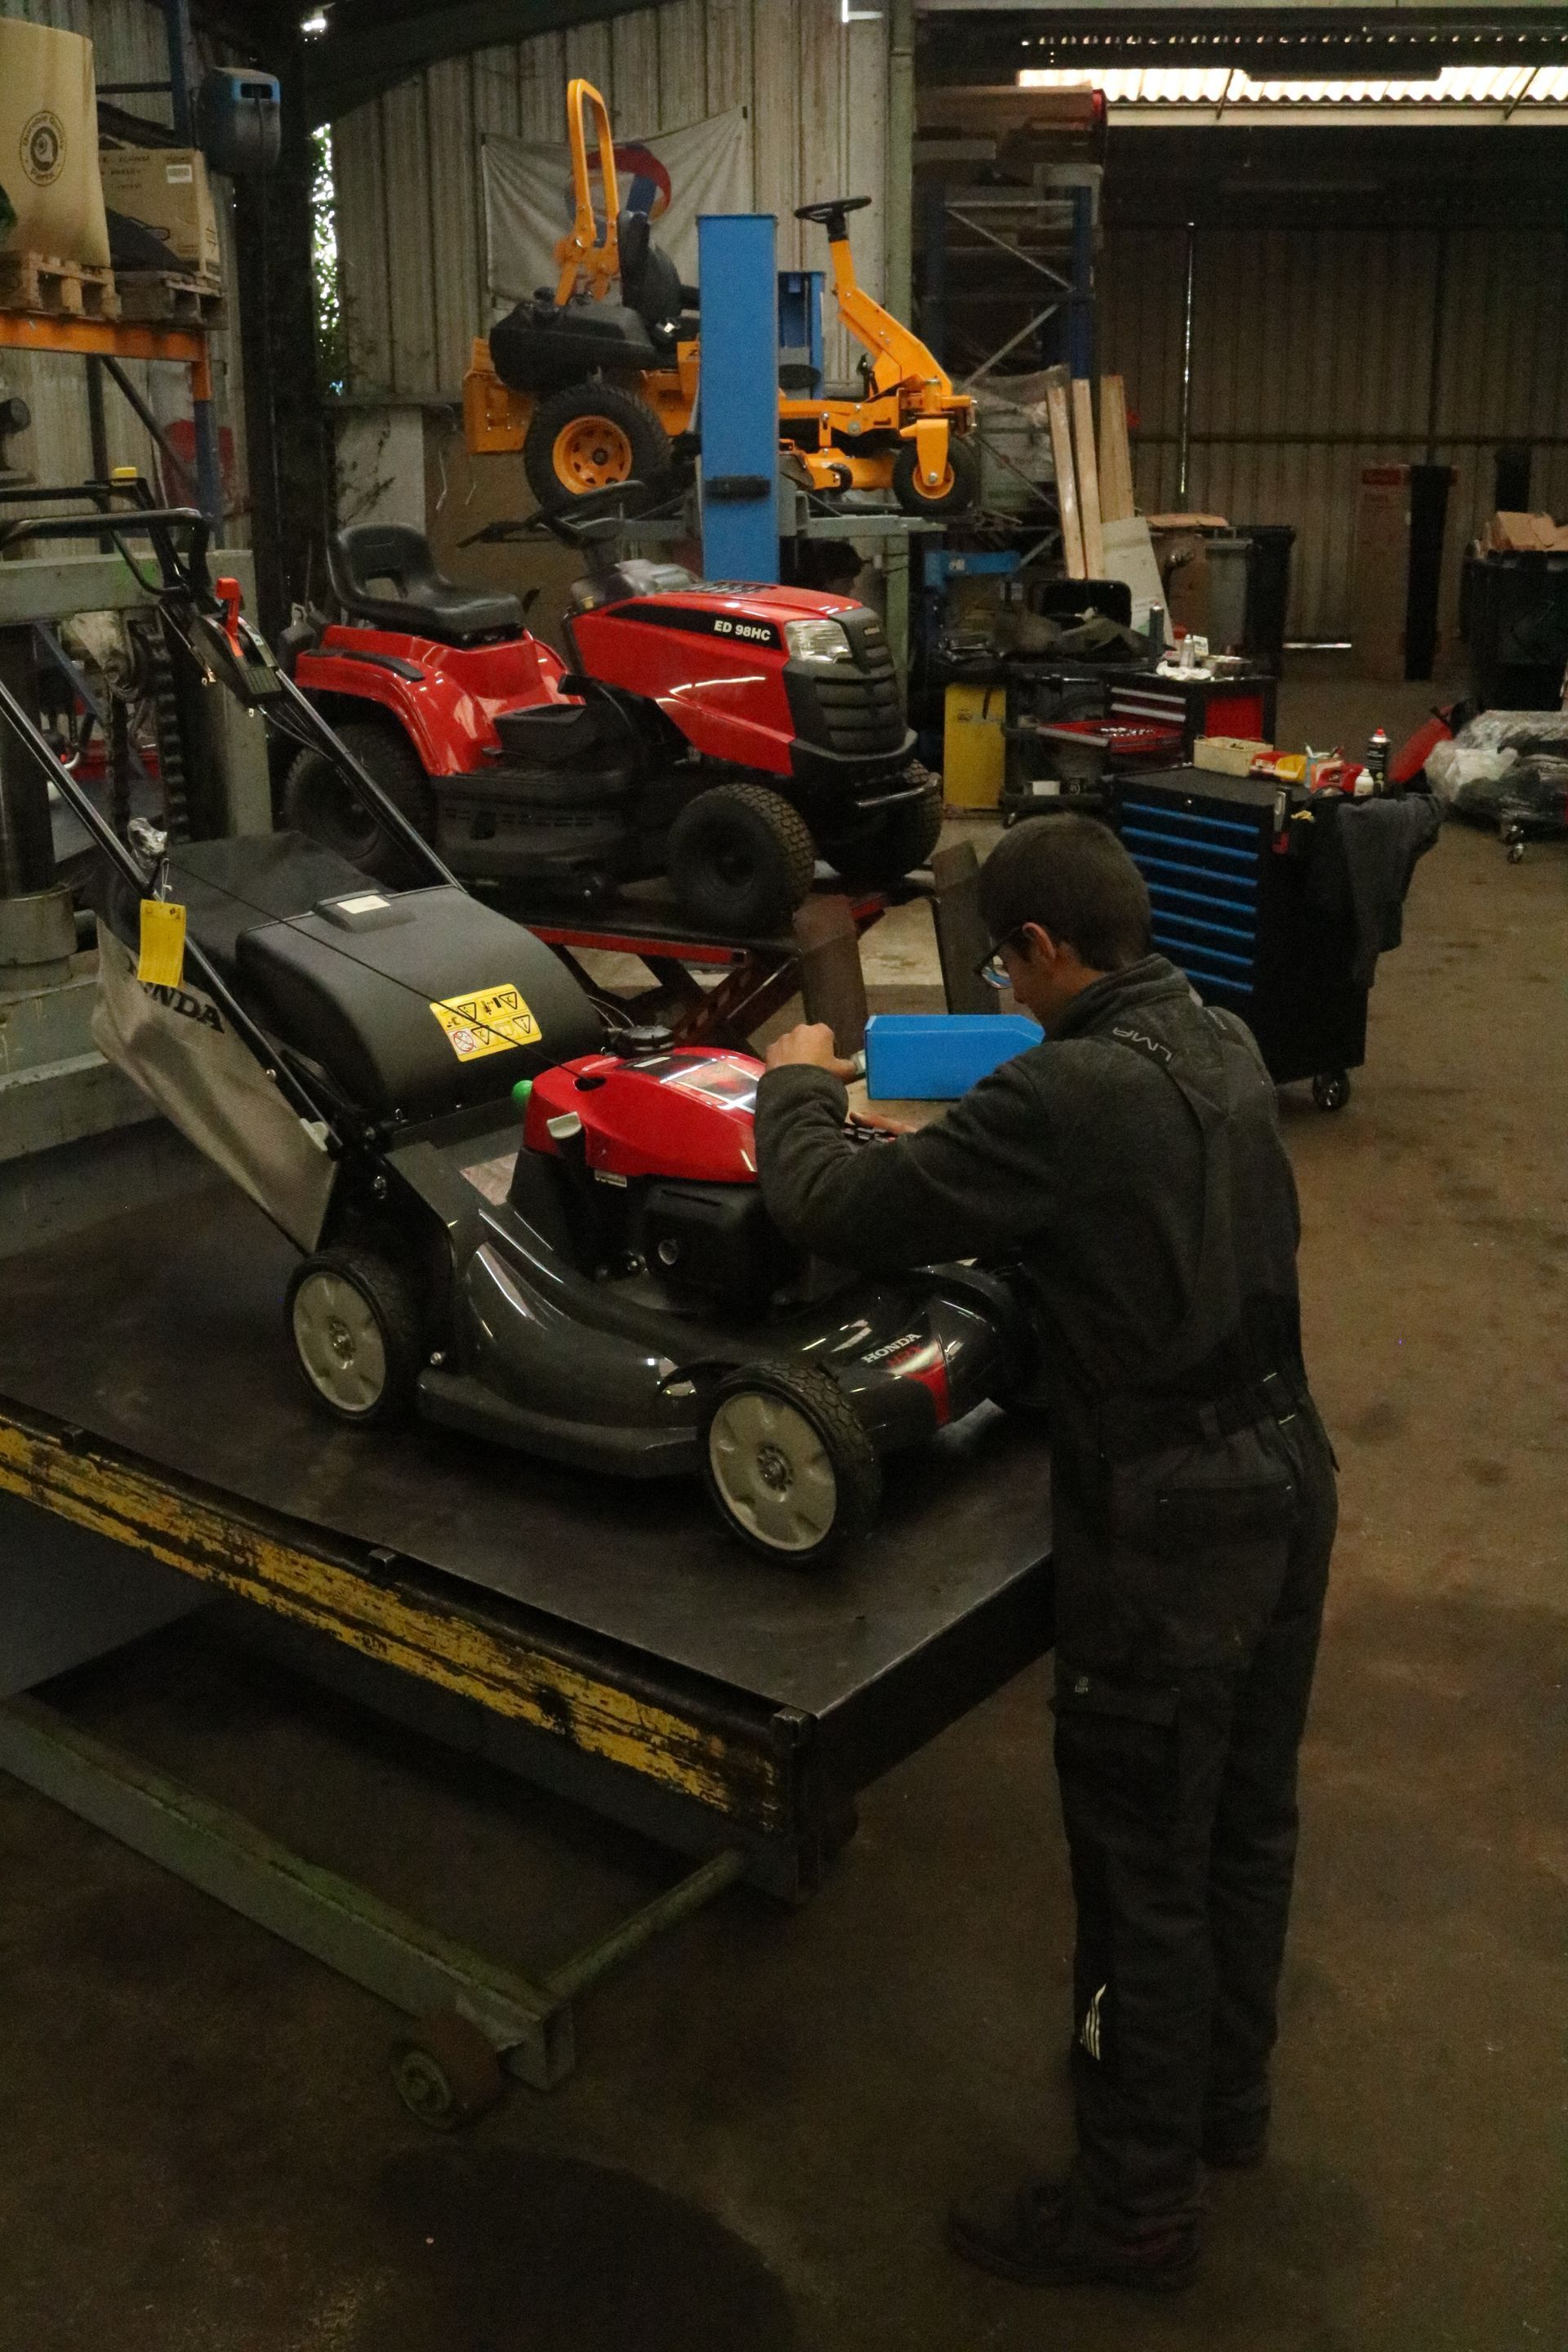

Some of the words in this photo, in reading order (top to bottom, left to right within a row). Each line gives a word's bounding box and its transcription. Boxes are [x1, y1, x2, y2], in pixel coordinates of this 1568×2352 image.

[714, 620, 733, 633] ED
[735, 624, 771, 641] 98HC
[140, 979, 225, 1035] NDA
[1112, 1027, 1172, 1062] LMA
[860, 1334, 923, 1363] HONDA
